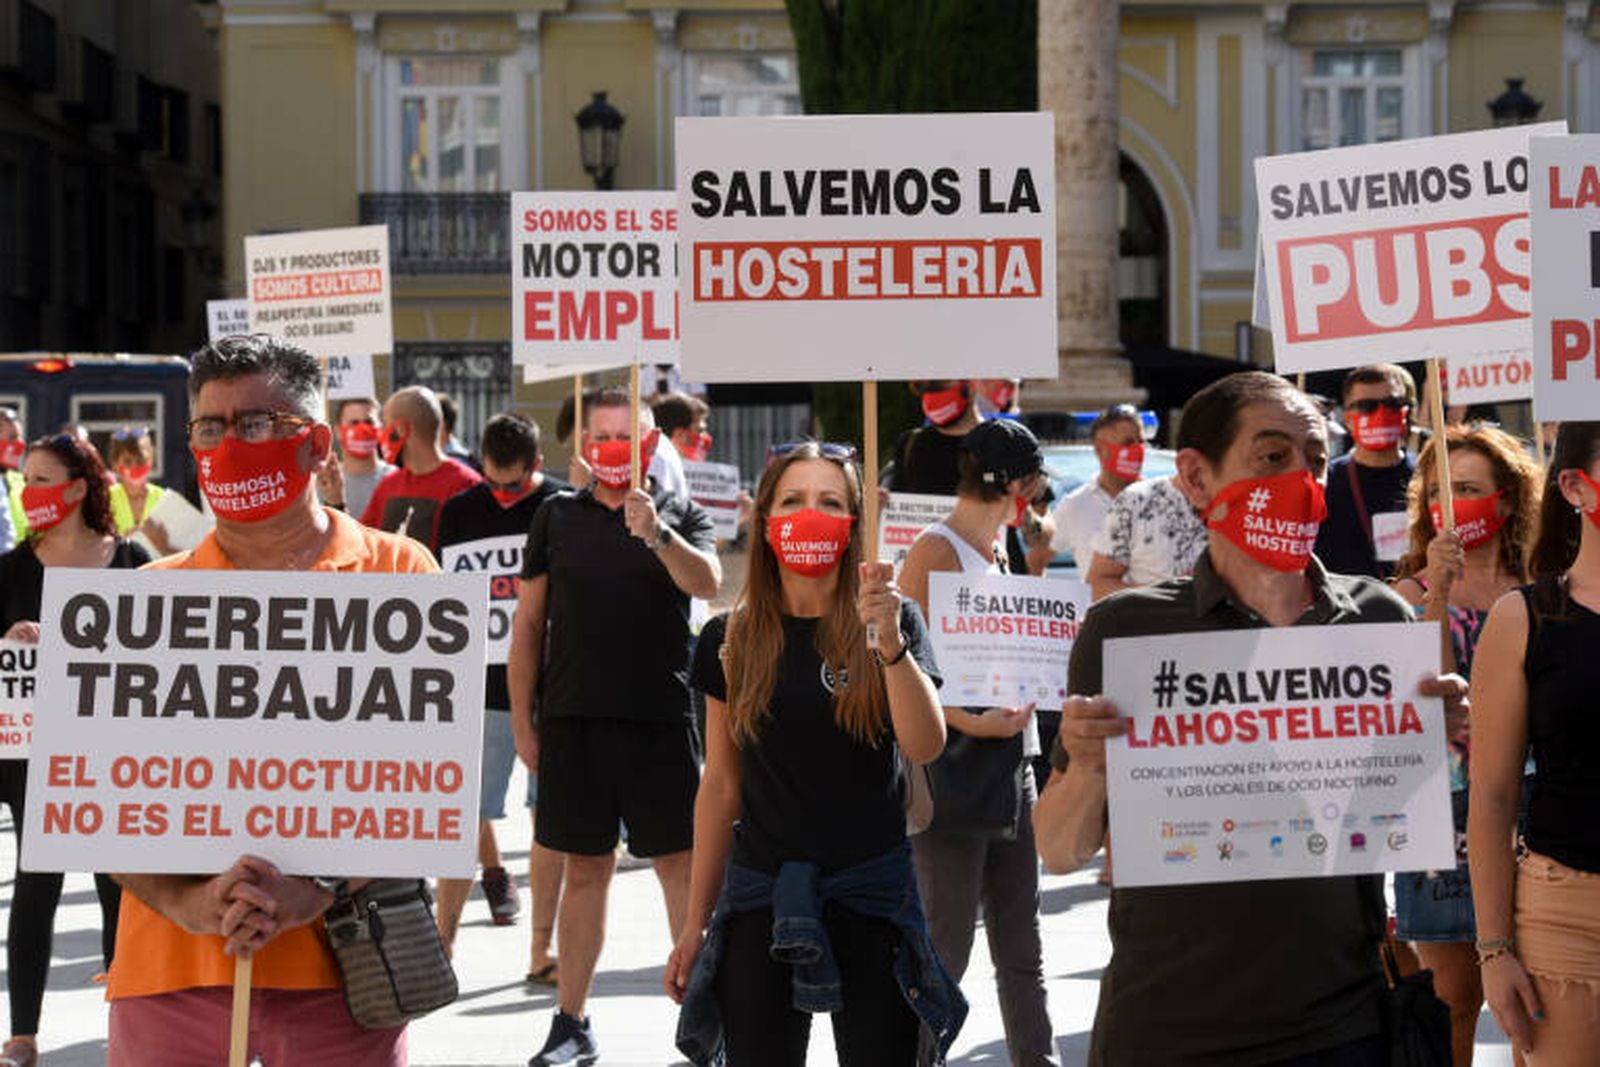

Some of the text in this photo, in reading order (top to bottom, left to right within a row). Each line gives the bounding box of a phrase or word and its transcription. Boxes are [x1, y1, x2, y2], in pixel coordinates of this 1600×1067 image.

[691, 167, 1042, 218] SALVEMOS LA
[1270, 163, 1471, 220] SALVEMOS
[524, 209, 607, 232] SOMOS
[615, 209, 642, 232] EL
[290, 250, 380, 270] PRODUCTORES
[522, 242, 661, 278] MOTOR
[698, 237, 1036, 299] HOSTELERÍA
[1288, 217, 1531, 336] PUBS
[311, 271, 379, 295] CULTURA
[524, 290, 679, 341] EMPL
[1551, 318, 1600, 382] P
[1247, 487, 1271, 514] #
[60, 592, 470, 655] QUEREMOS
[956, 586, 1076, 620] #SALVEMOS
[66, 661, 456, 723] TRABAJAR
[1153, 660, 1393, 709] #SALVEMOS
[47, 755, 464, 794] EL OCIO NOCTURNO
[1288, 778, 1322, 792] OCIO
[43, 803, 462, 841] NO ES EL CULPABLE
